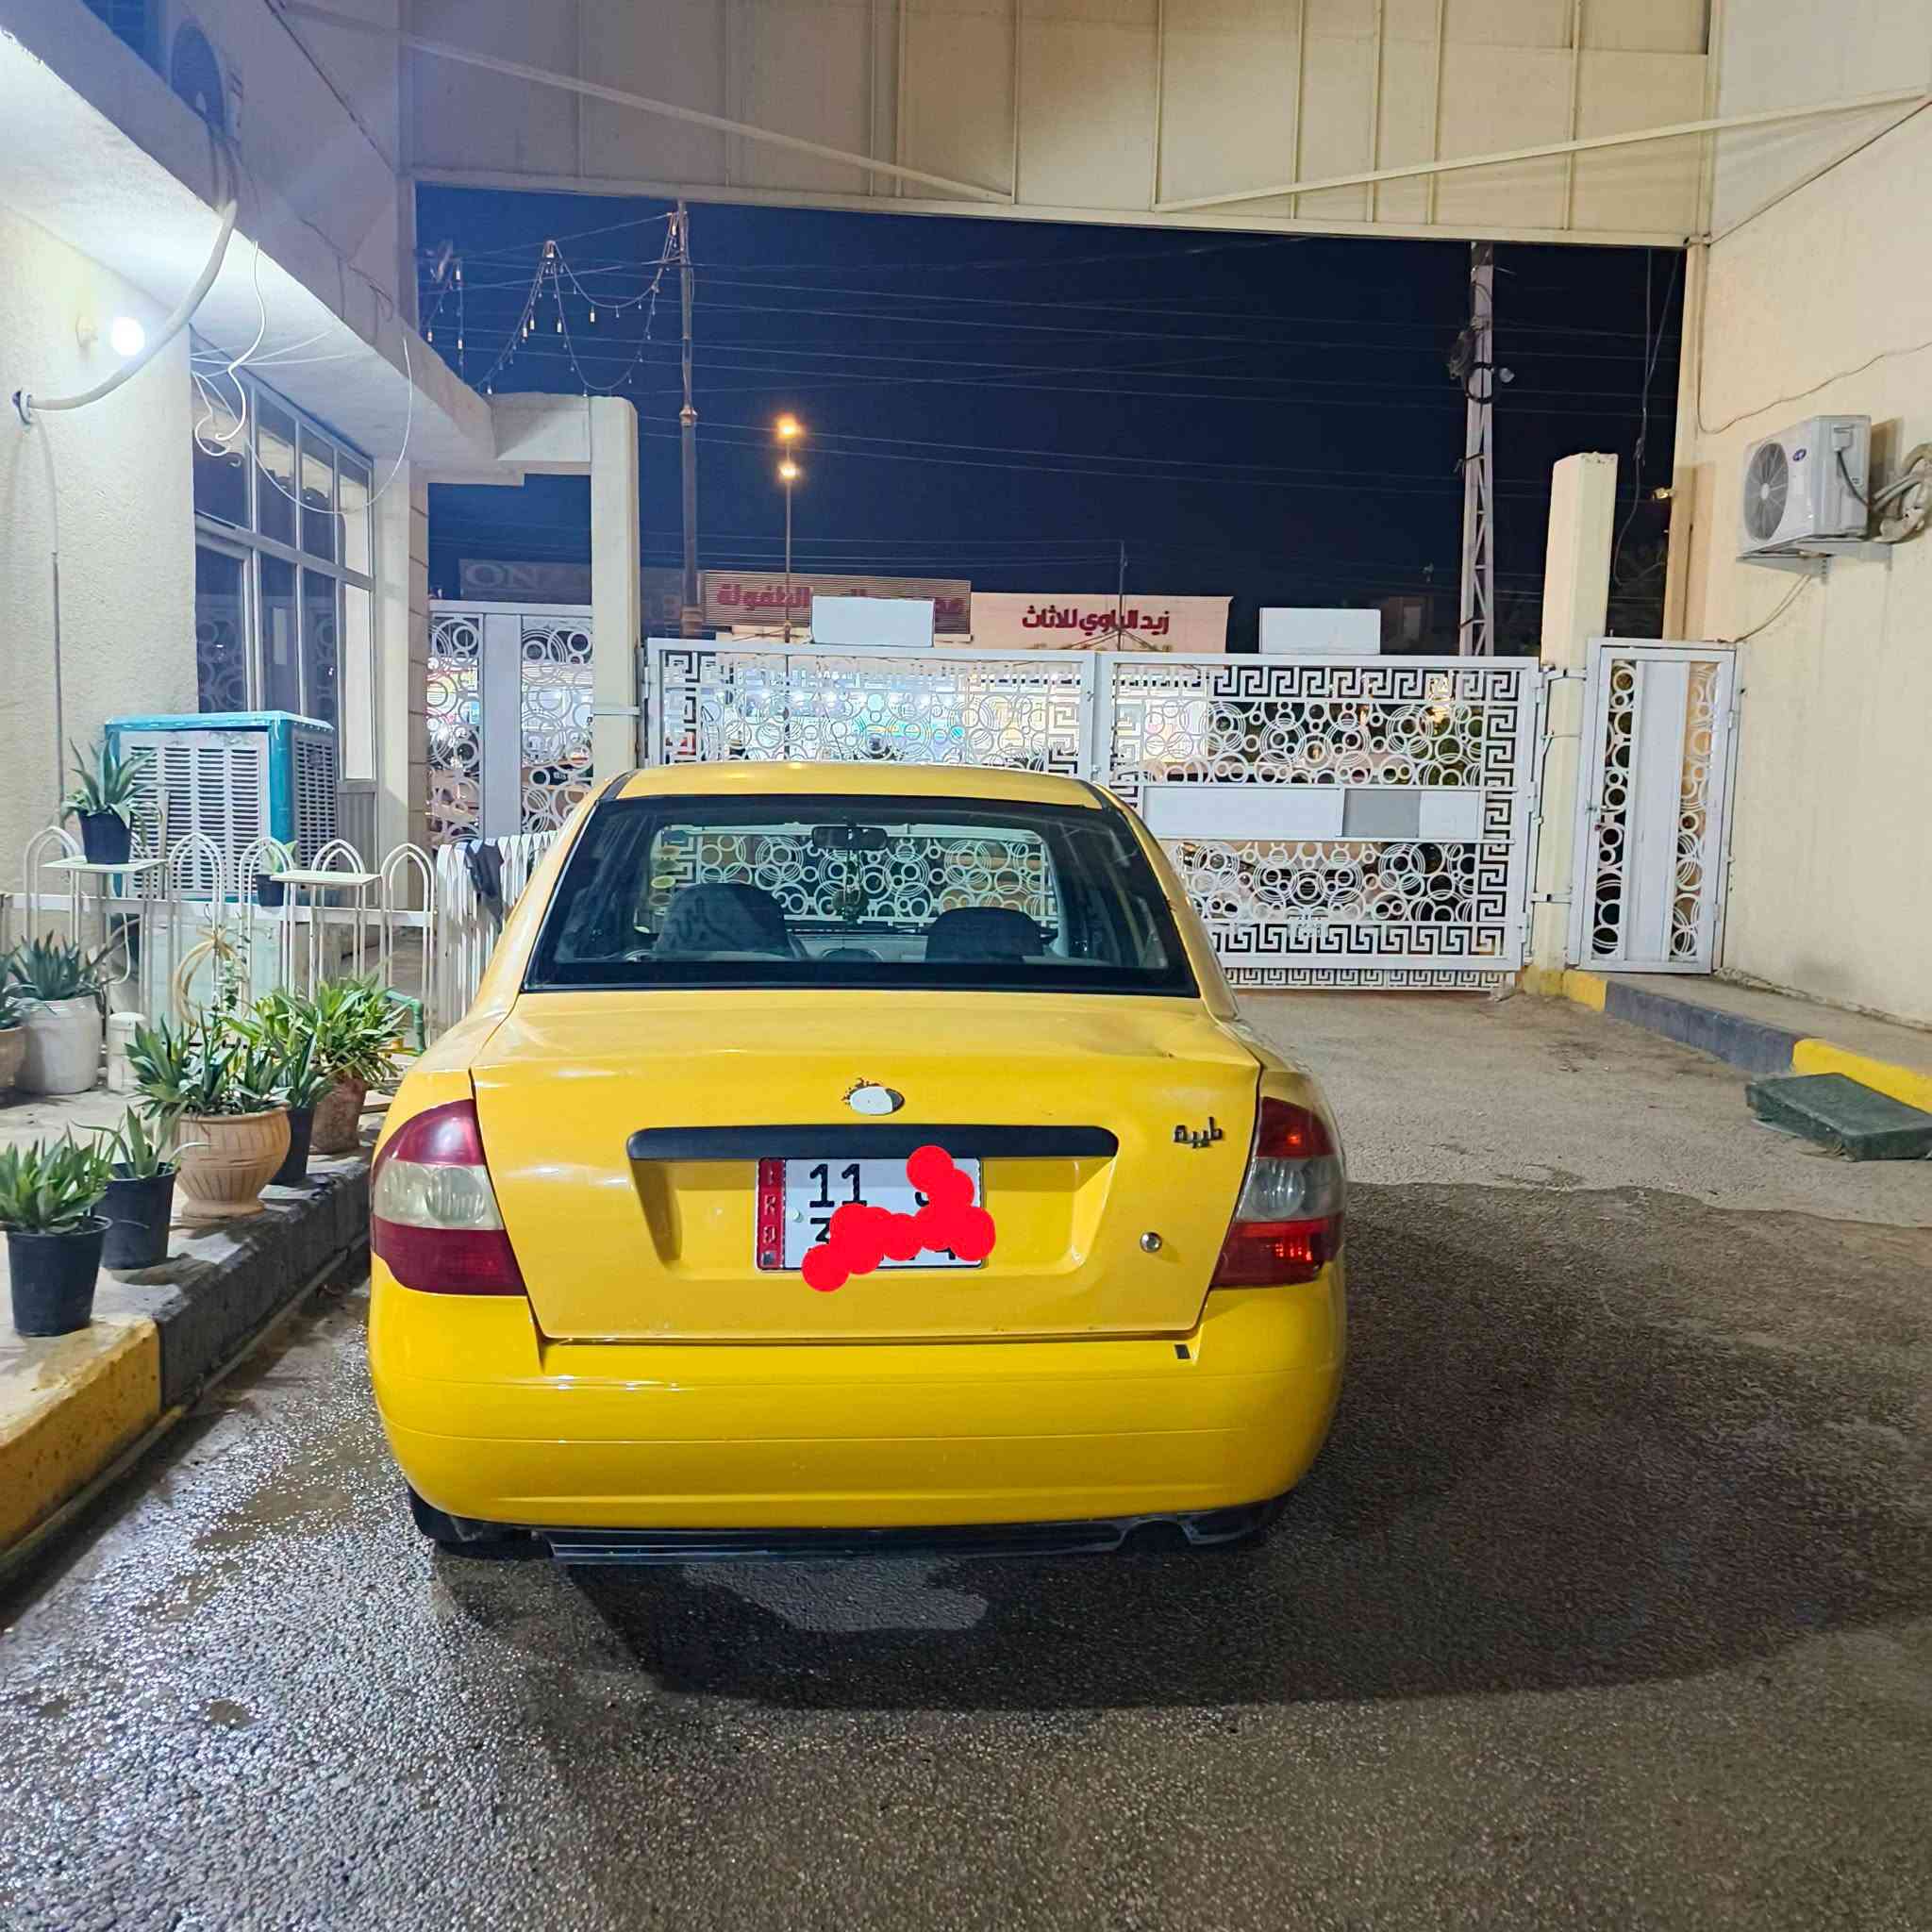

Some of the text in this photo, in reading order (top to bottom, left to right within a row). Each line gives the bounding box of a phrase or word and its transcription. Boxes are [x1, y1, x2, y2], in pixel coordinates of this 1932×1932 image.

[1022, 605, 1077, 628] للاثاث
[1140, 611, 1170, 635] زيد
[809, 1164, 867, 1208] 11
